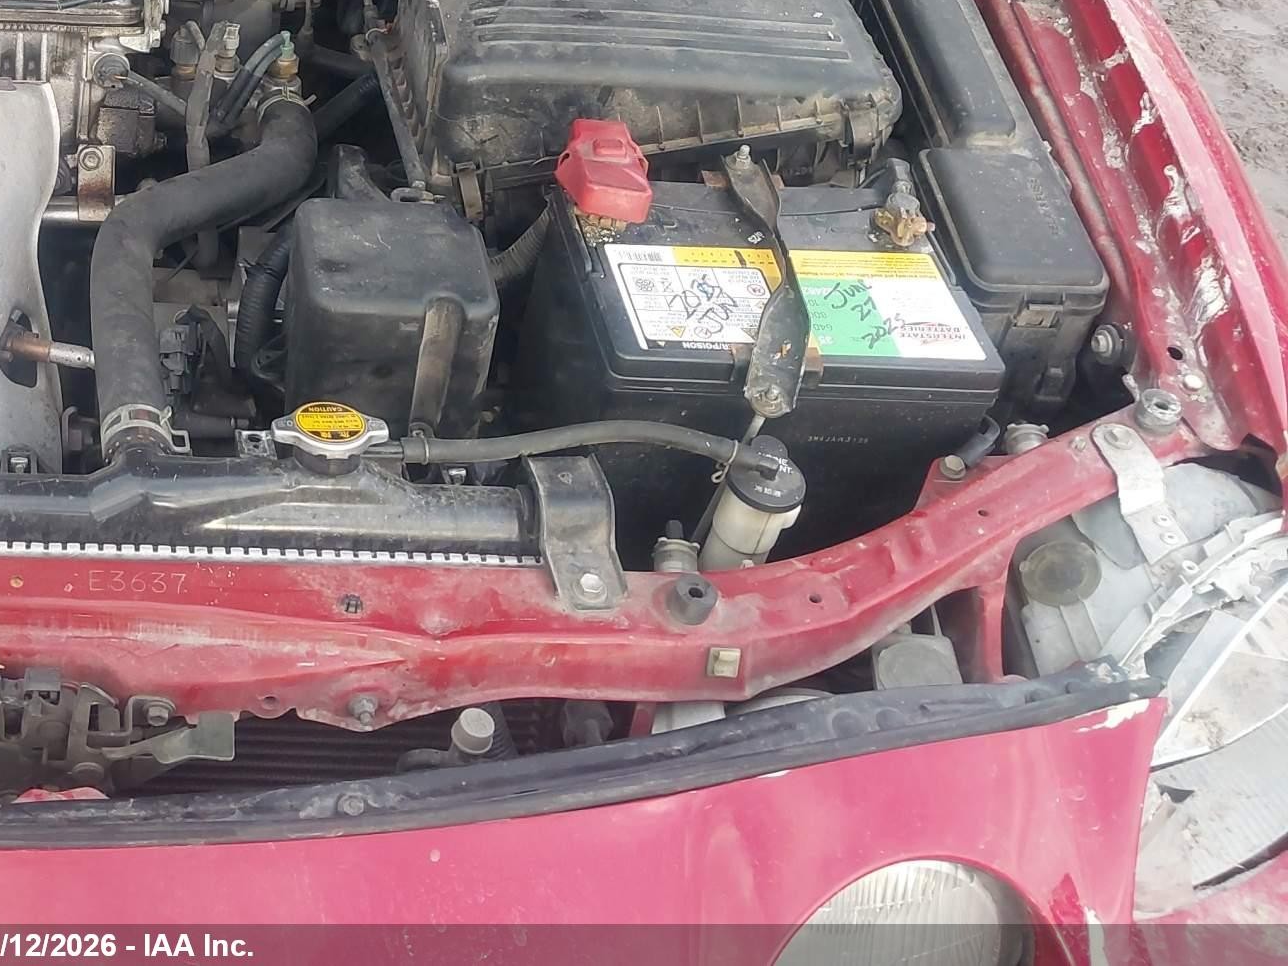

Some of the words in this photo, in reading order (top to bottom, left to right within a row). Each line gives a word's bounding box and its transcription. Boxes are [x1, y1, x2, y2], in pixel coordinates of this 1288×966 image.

[861, 313, 906, 350] 2025
[682, 341, 730, 350] R/POISON
[88, 569, 187, 595] E3637
